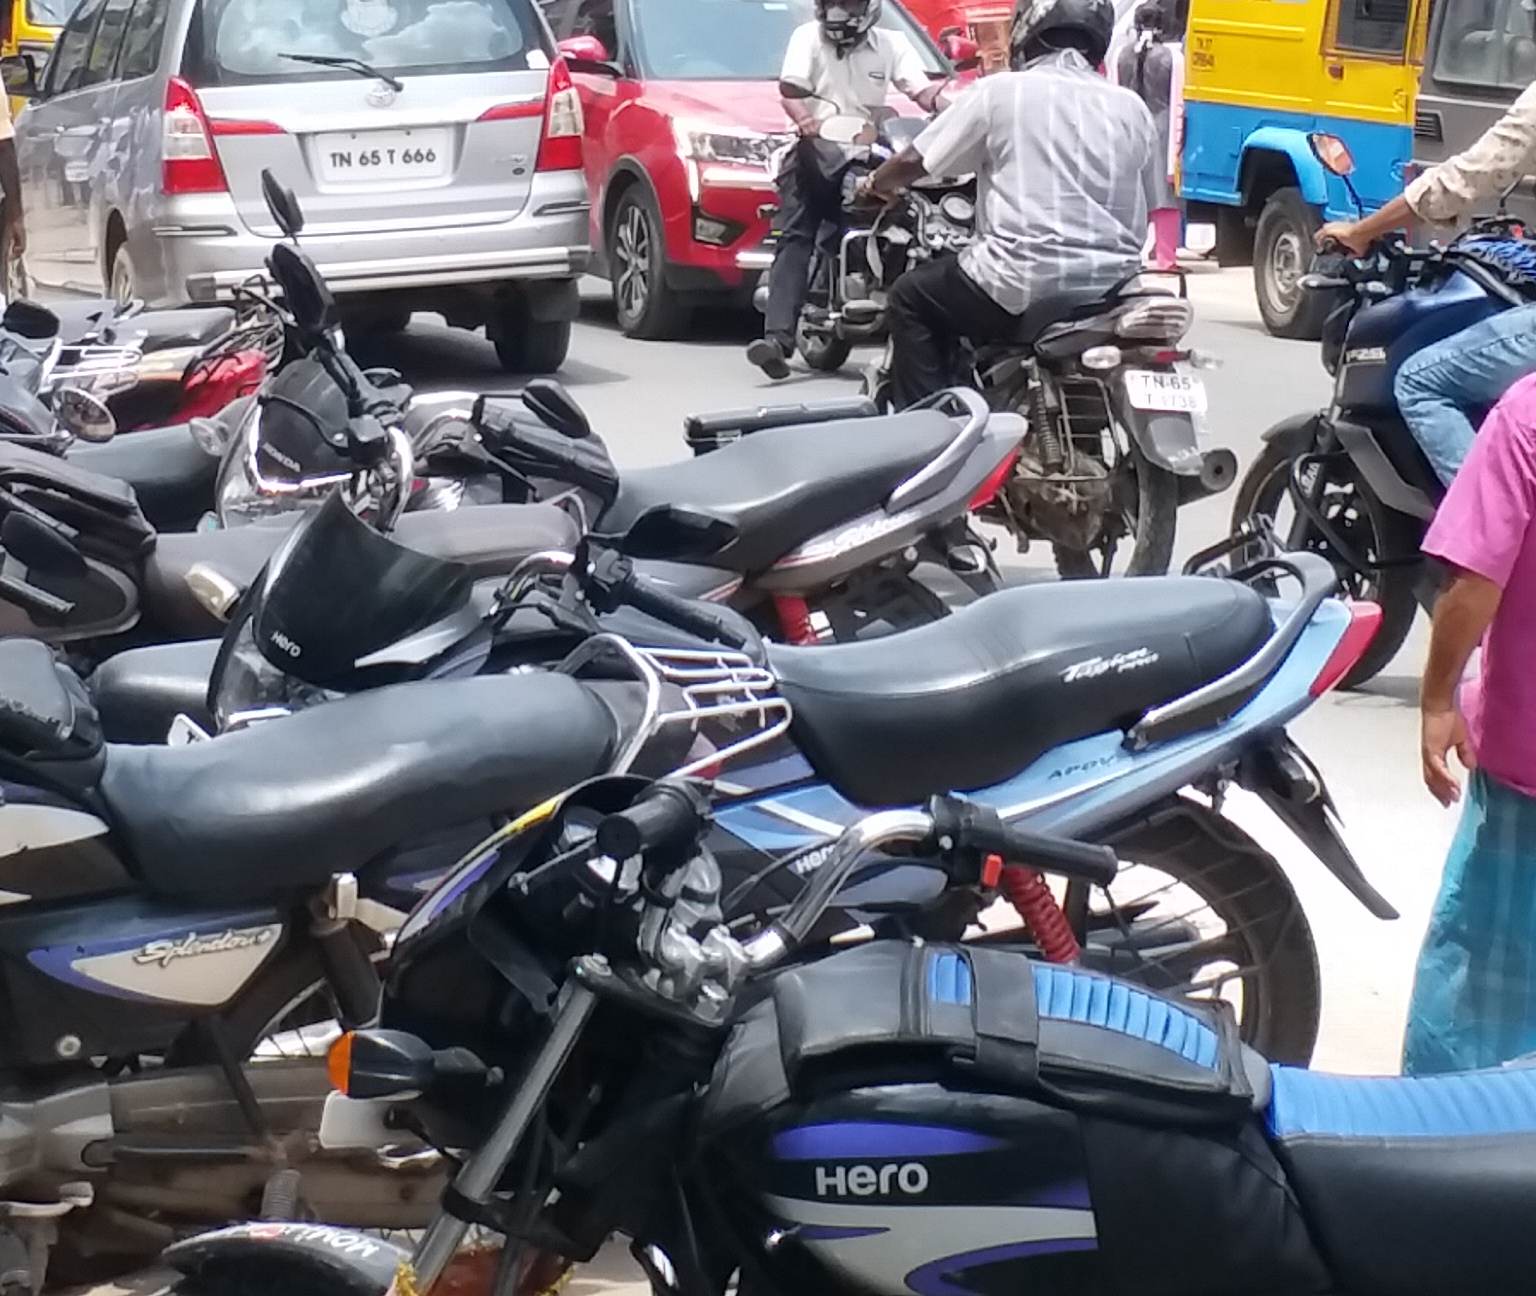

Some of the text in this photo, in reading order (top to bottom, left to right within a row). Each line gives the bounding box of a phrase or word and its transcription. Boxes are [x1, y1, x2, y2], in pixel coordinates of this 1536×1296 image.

[331, 148, 437, 168] TN 65 T 666
[270, 629, 302, 658] Hero
[815, 1162, 929, 1196] Hero
